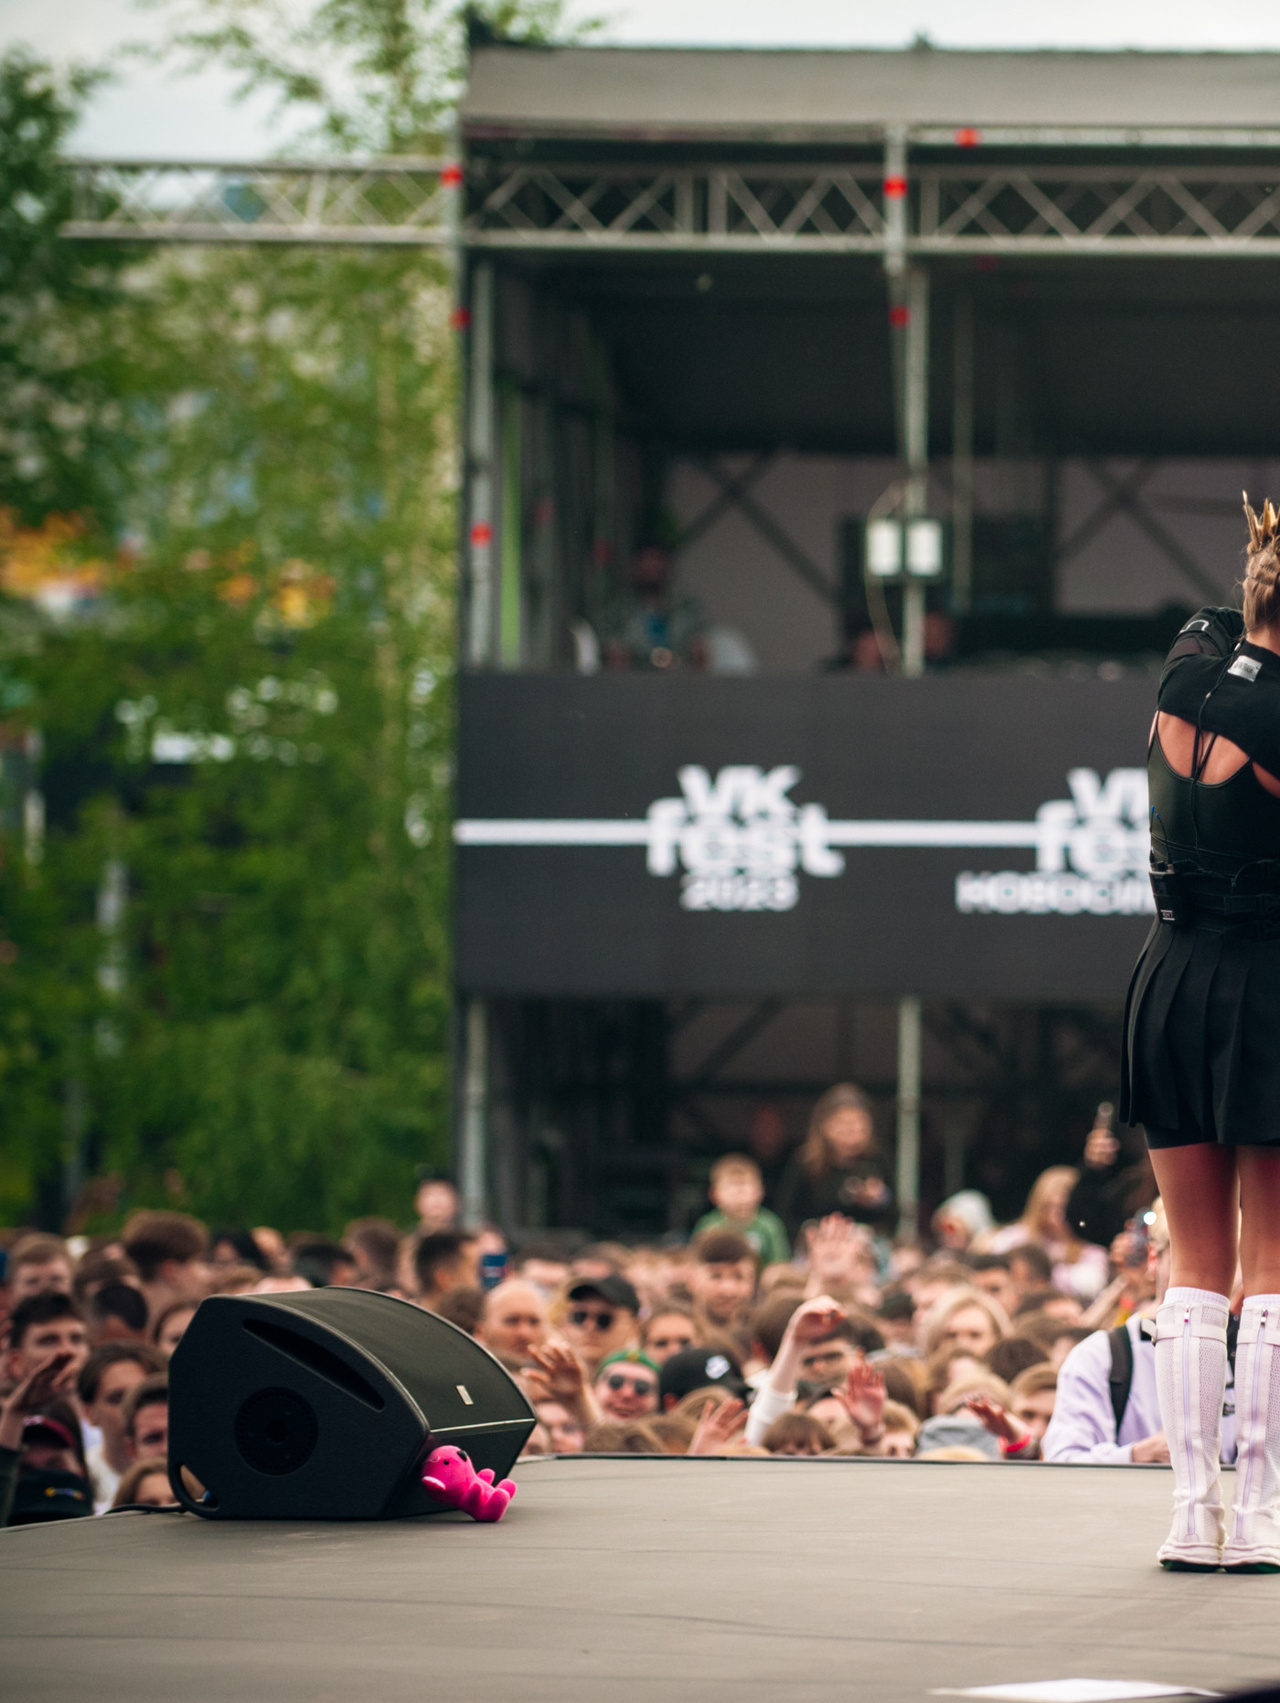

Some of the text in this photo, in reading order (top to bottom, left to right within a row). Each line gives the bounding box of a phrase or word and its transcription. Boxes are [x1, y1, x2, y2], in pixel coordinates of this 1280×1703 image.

[677, 764, 802, 819] VK
[647, 797, 846, 878] fest
[1036, 799, 1150, 881] fe
[679, 875, 799, 913] 2023
[954, 872, 1157, 915] НОВОСИ
